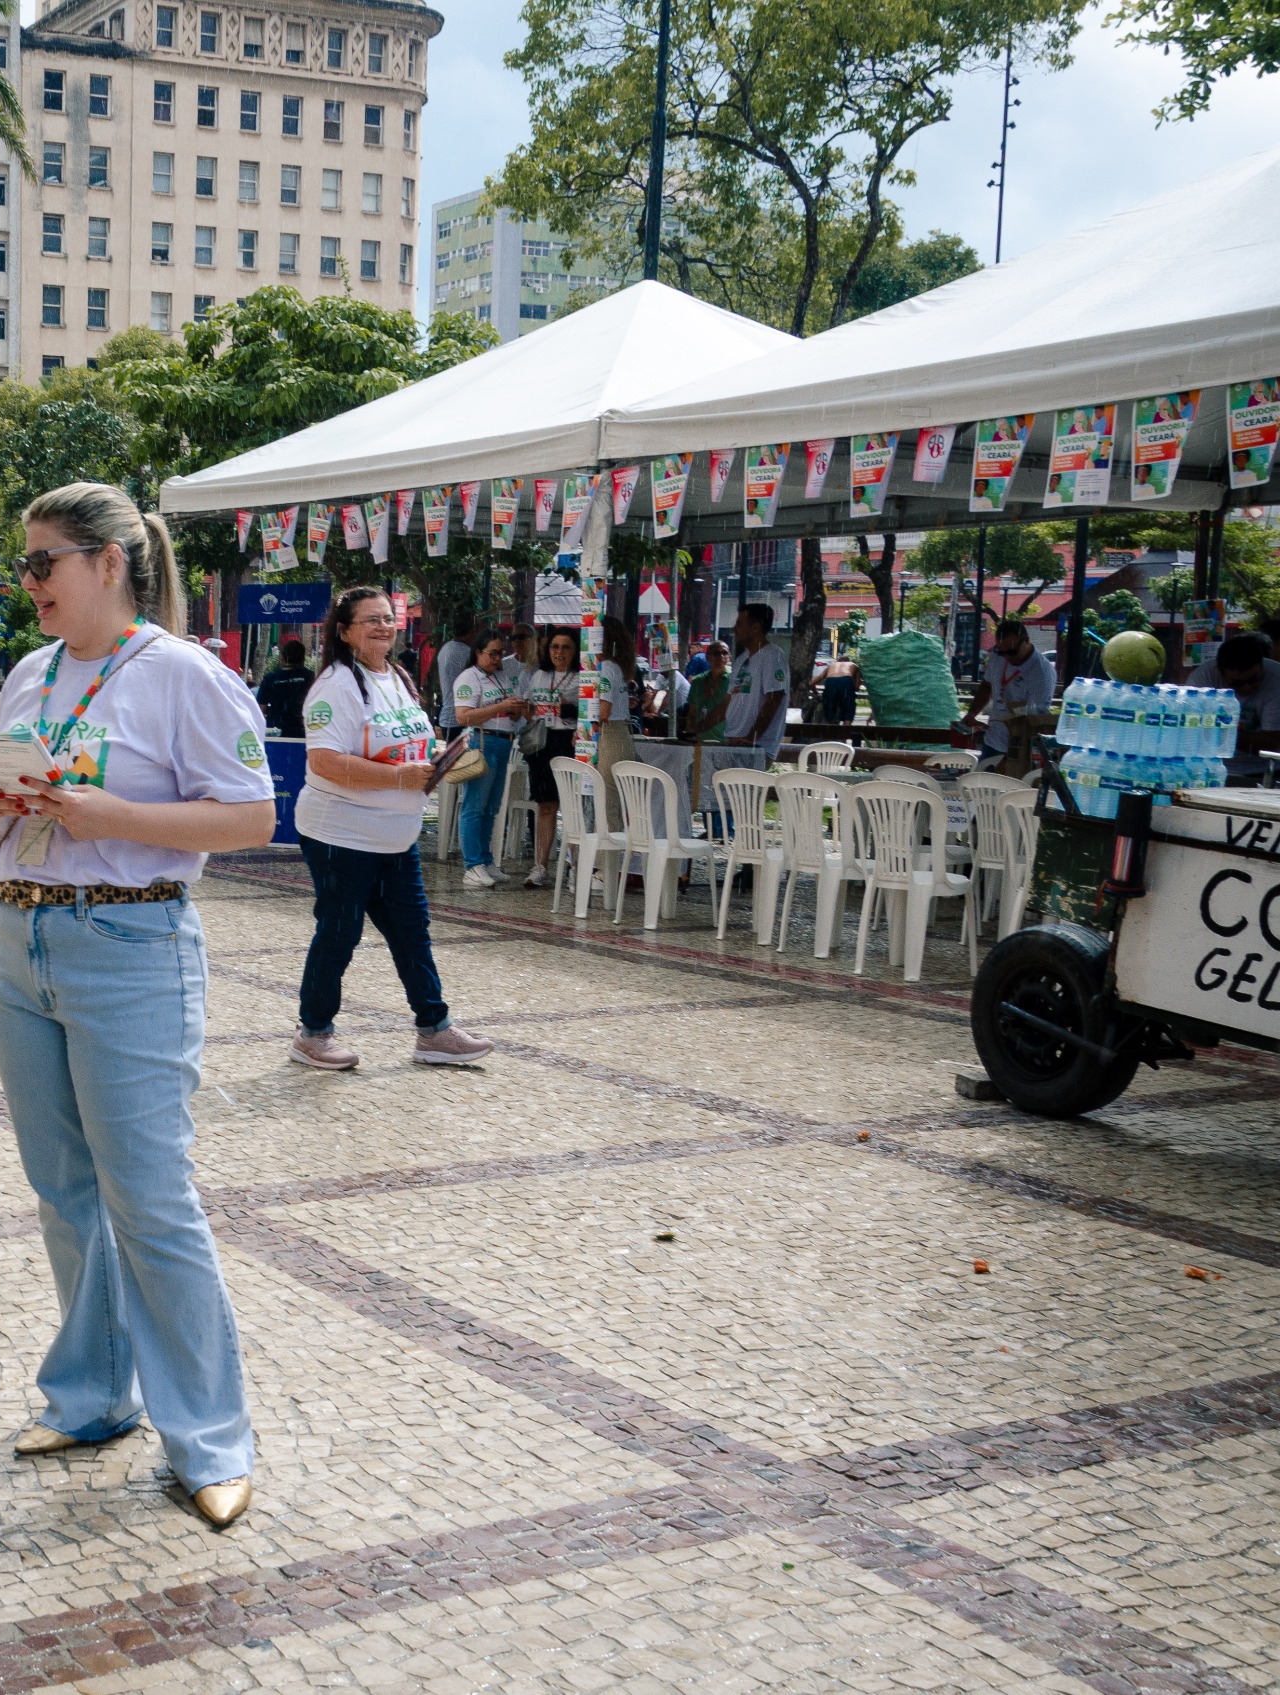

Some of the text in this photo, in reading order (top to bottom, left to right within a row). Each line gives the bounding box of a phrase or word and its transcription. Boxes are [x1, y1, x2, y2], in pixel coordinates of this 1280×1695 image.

[1140, 422, 1186, 434] OUVIDORIA
[280, 599, 311, 607] Ouvidoria
[240, 745, 264, 761] 155
[1226, 816, 1280, 852] VE
